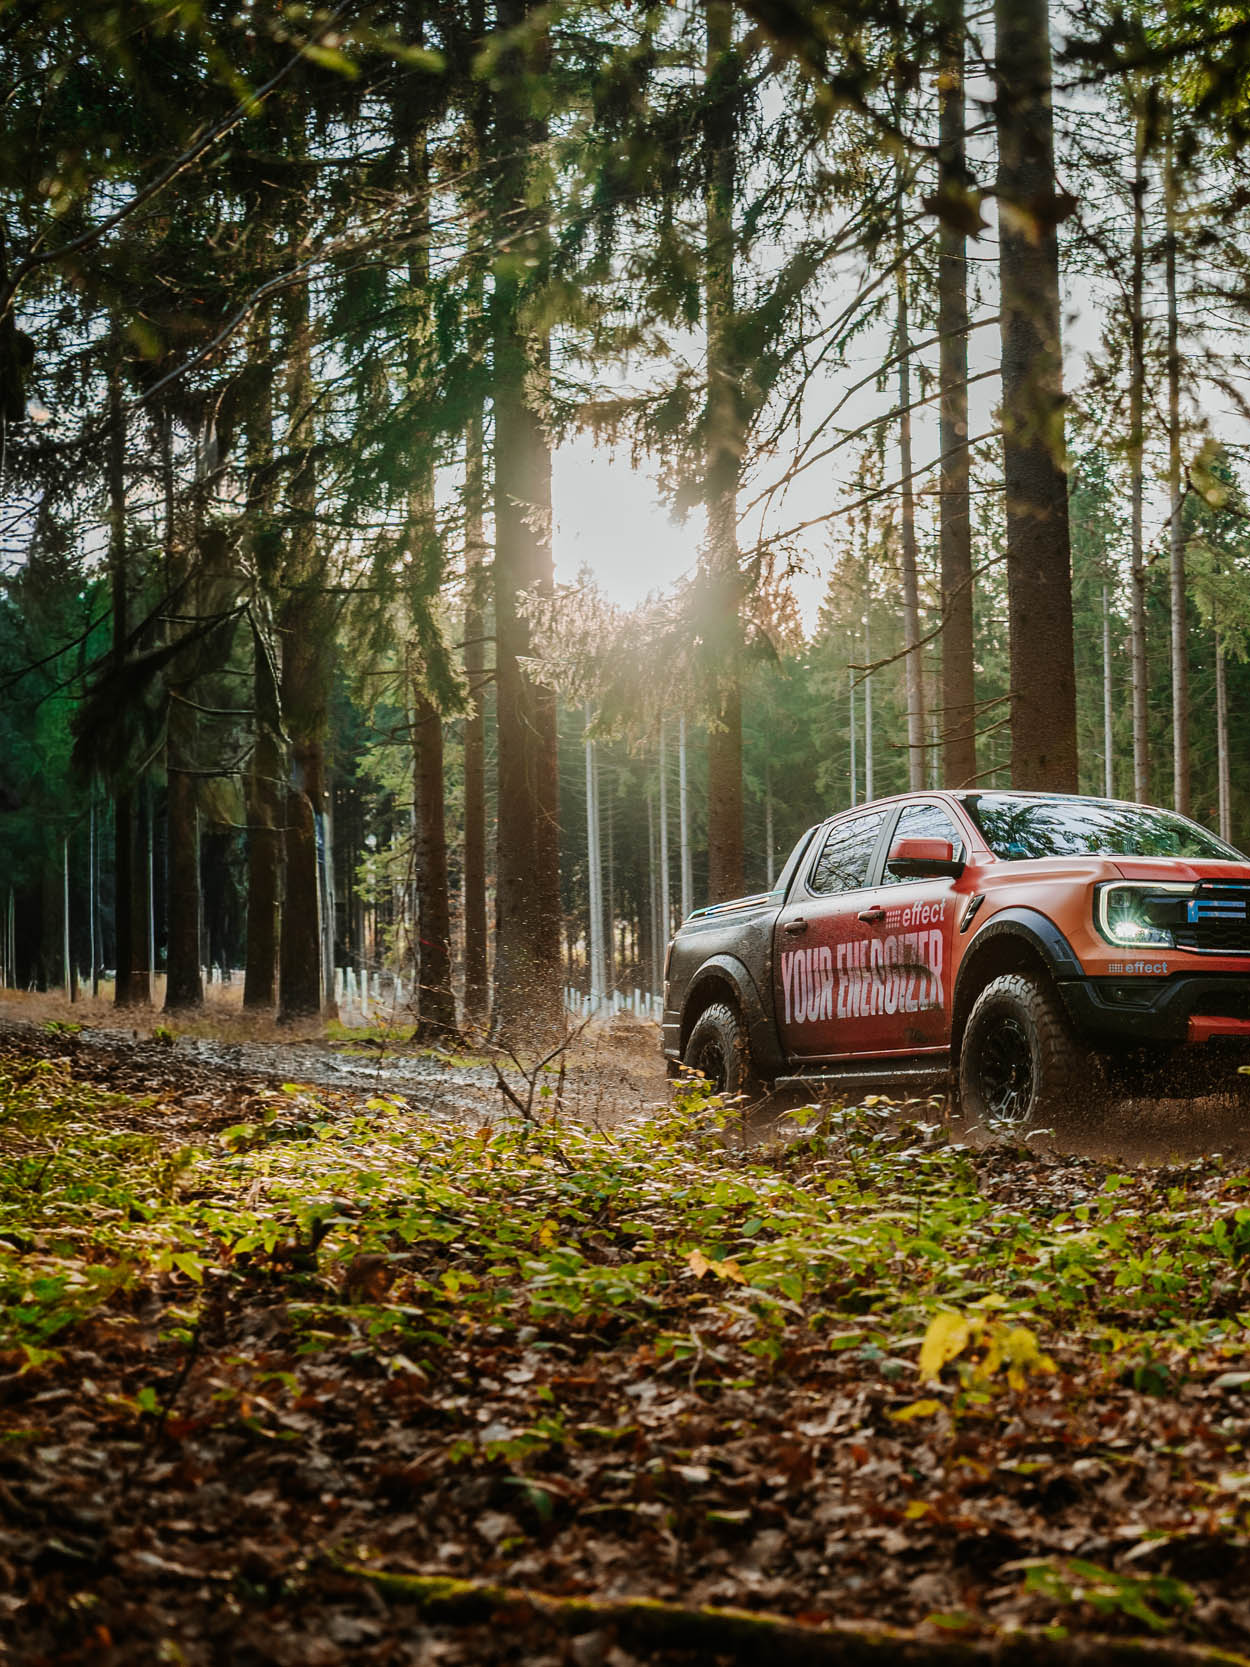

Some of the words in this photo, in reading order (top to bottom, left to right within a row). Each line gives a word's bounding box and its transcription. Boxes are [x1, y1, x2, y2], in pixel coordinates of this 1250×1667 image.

[902, 899, 946, 927] effect
[781, 946, 833, 1025] YOUR
[836, 929, 945, 1019] ENERGIZER
[1125, 961, 1168, 973] effect
